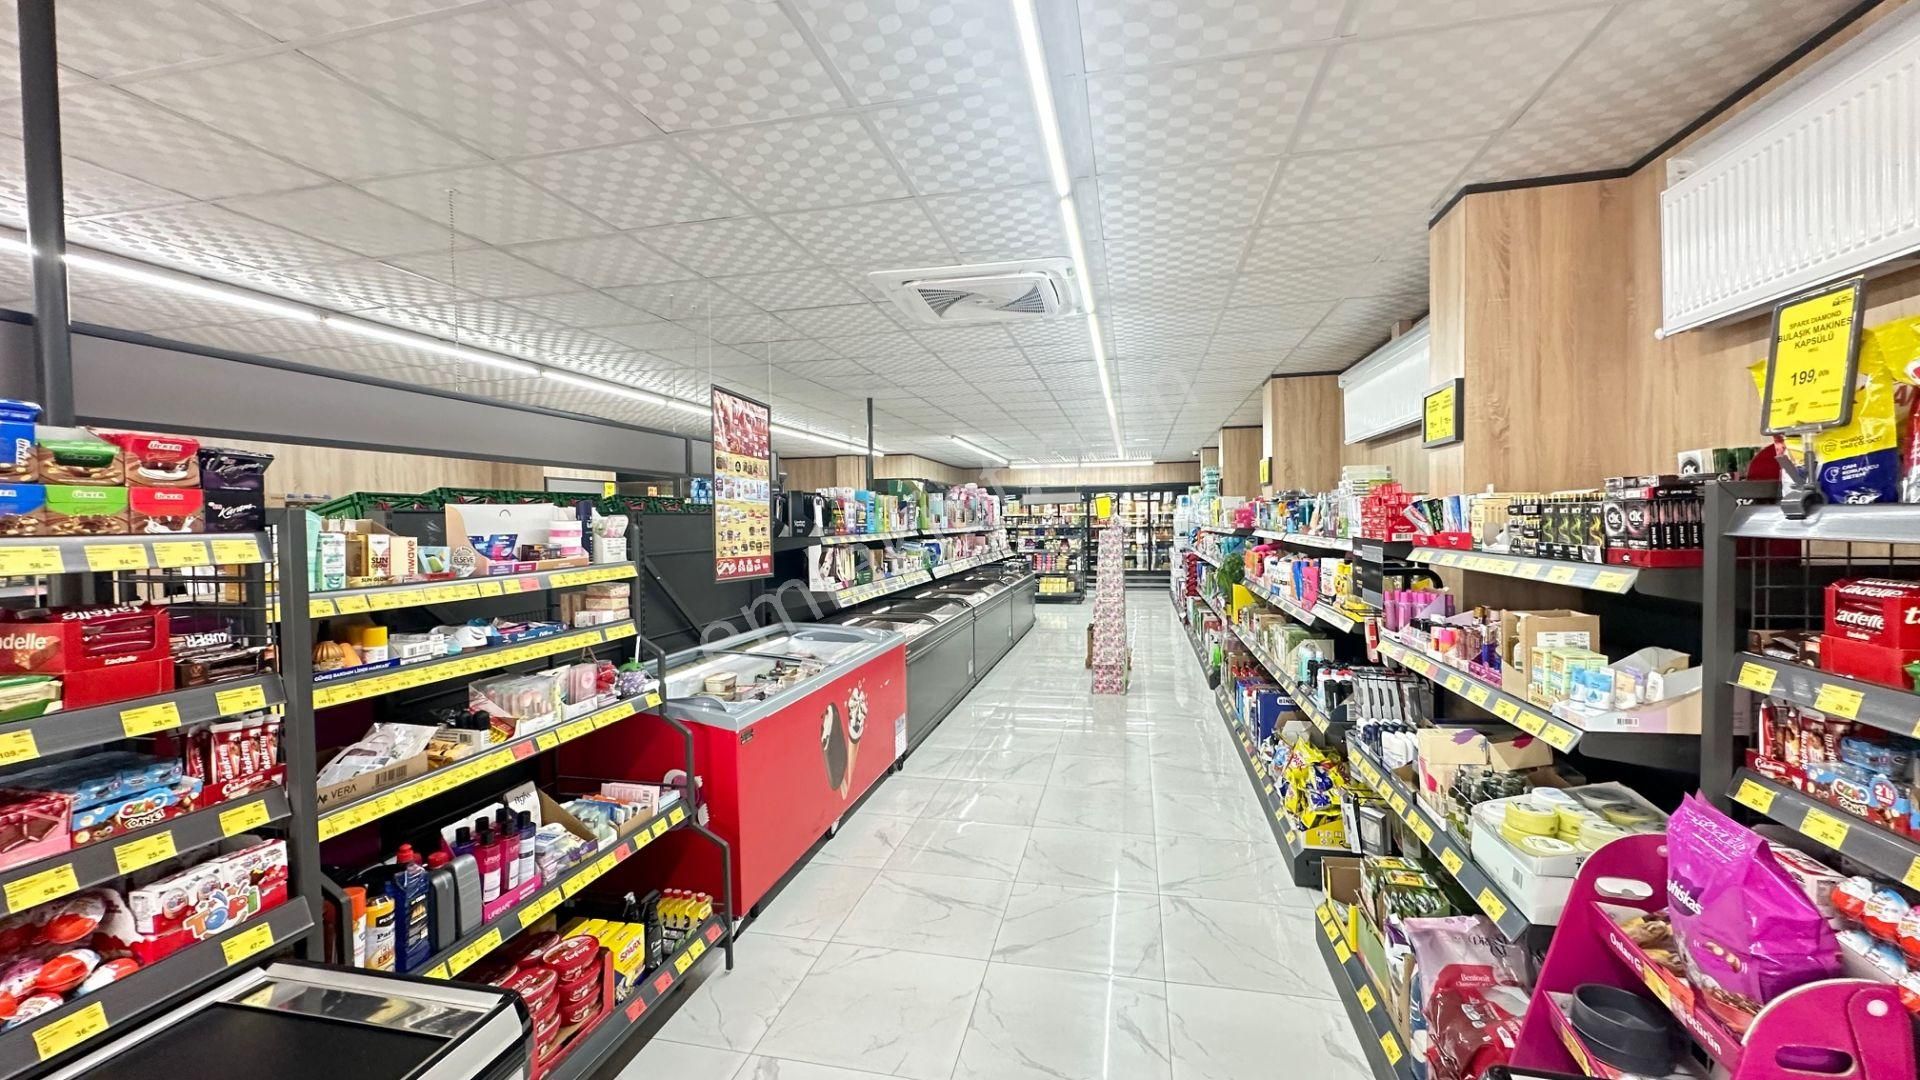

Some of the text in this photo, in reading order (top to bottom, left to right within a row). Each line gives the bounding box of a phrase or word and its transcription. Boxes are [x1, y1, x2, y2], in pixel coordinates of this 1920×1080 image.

[1810, 310, 1842, 325] DIAMOND
[1778, 327, 1811, 344] BULAŞIK
[1795, 331, 1834, 350] KAPSÜLÜ
[371, 556, 388, 564] SUN
[330, 783, 357, 799] VERA
